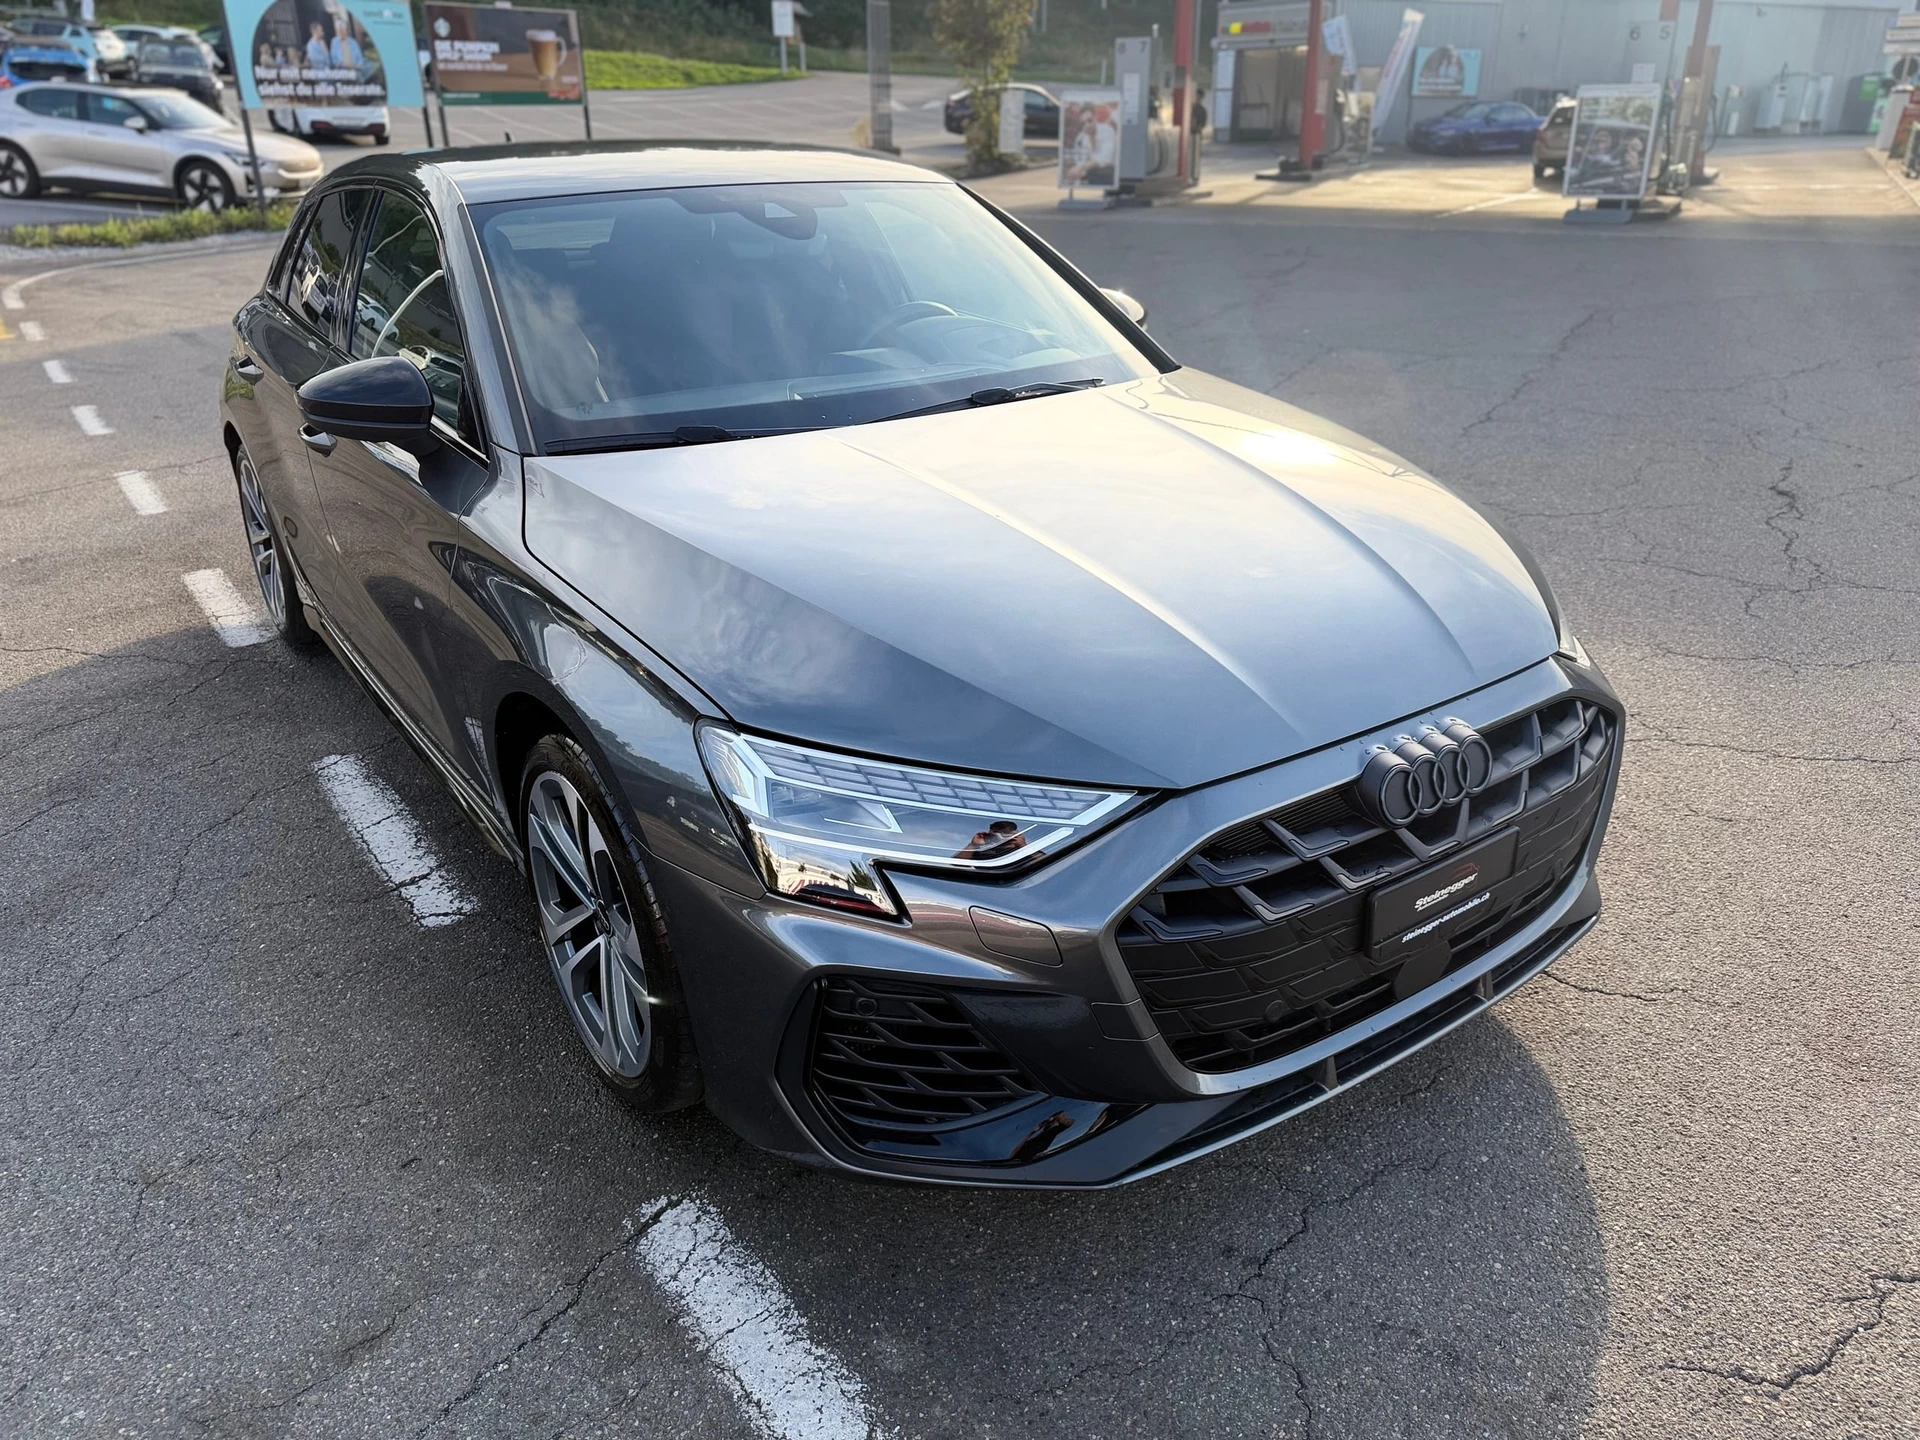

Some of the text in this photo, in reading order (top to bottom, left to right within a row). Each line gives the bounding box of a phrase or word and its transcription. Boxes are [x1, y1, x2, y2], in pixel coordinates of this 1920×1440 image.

[1630, 25, 1671, 41] 6 5
[254, 65, 357, 80] Nur mit newhome
[258, 82, 294, 96] siehst
[296, 82, 313, 96] du
[314, 82, 335, 96] alle
[1414, 872, 1478, 909] Steinegger
[1401, 892, 1491, 943] steinegger-automobile.ch
